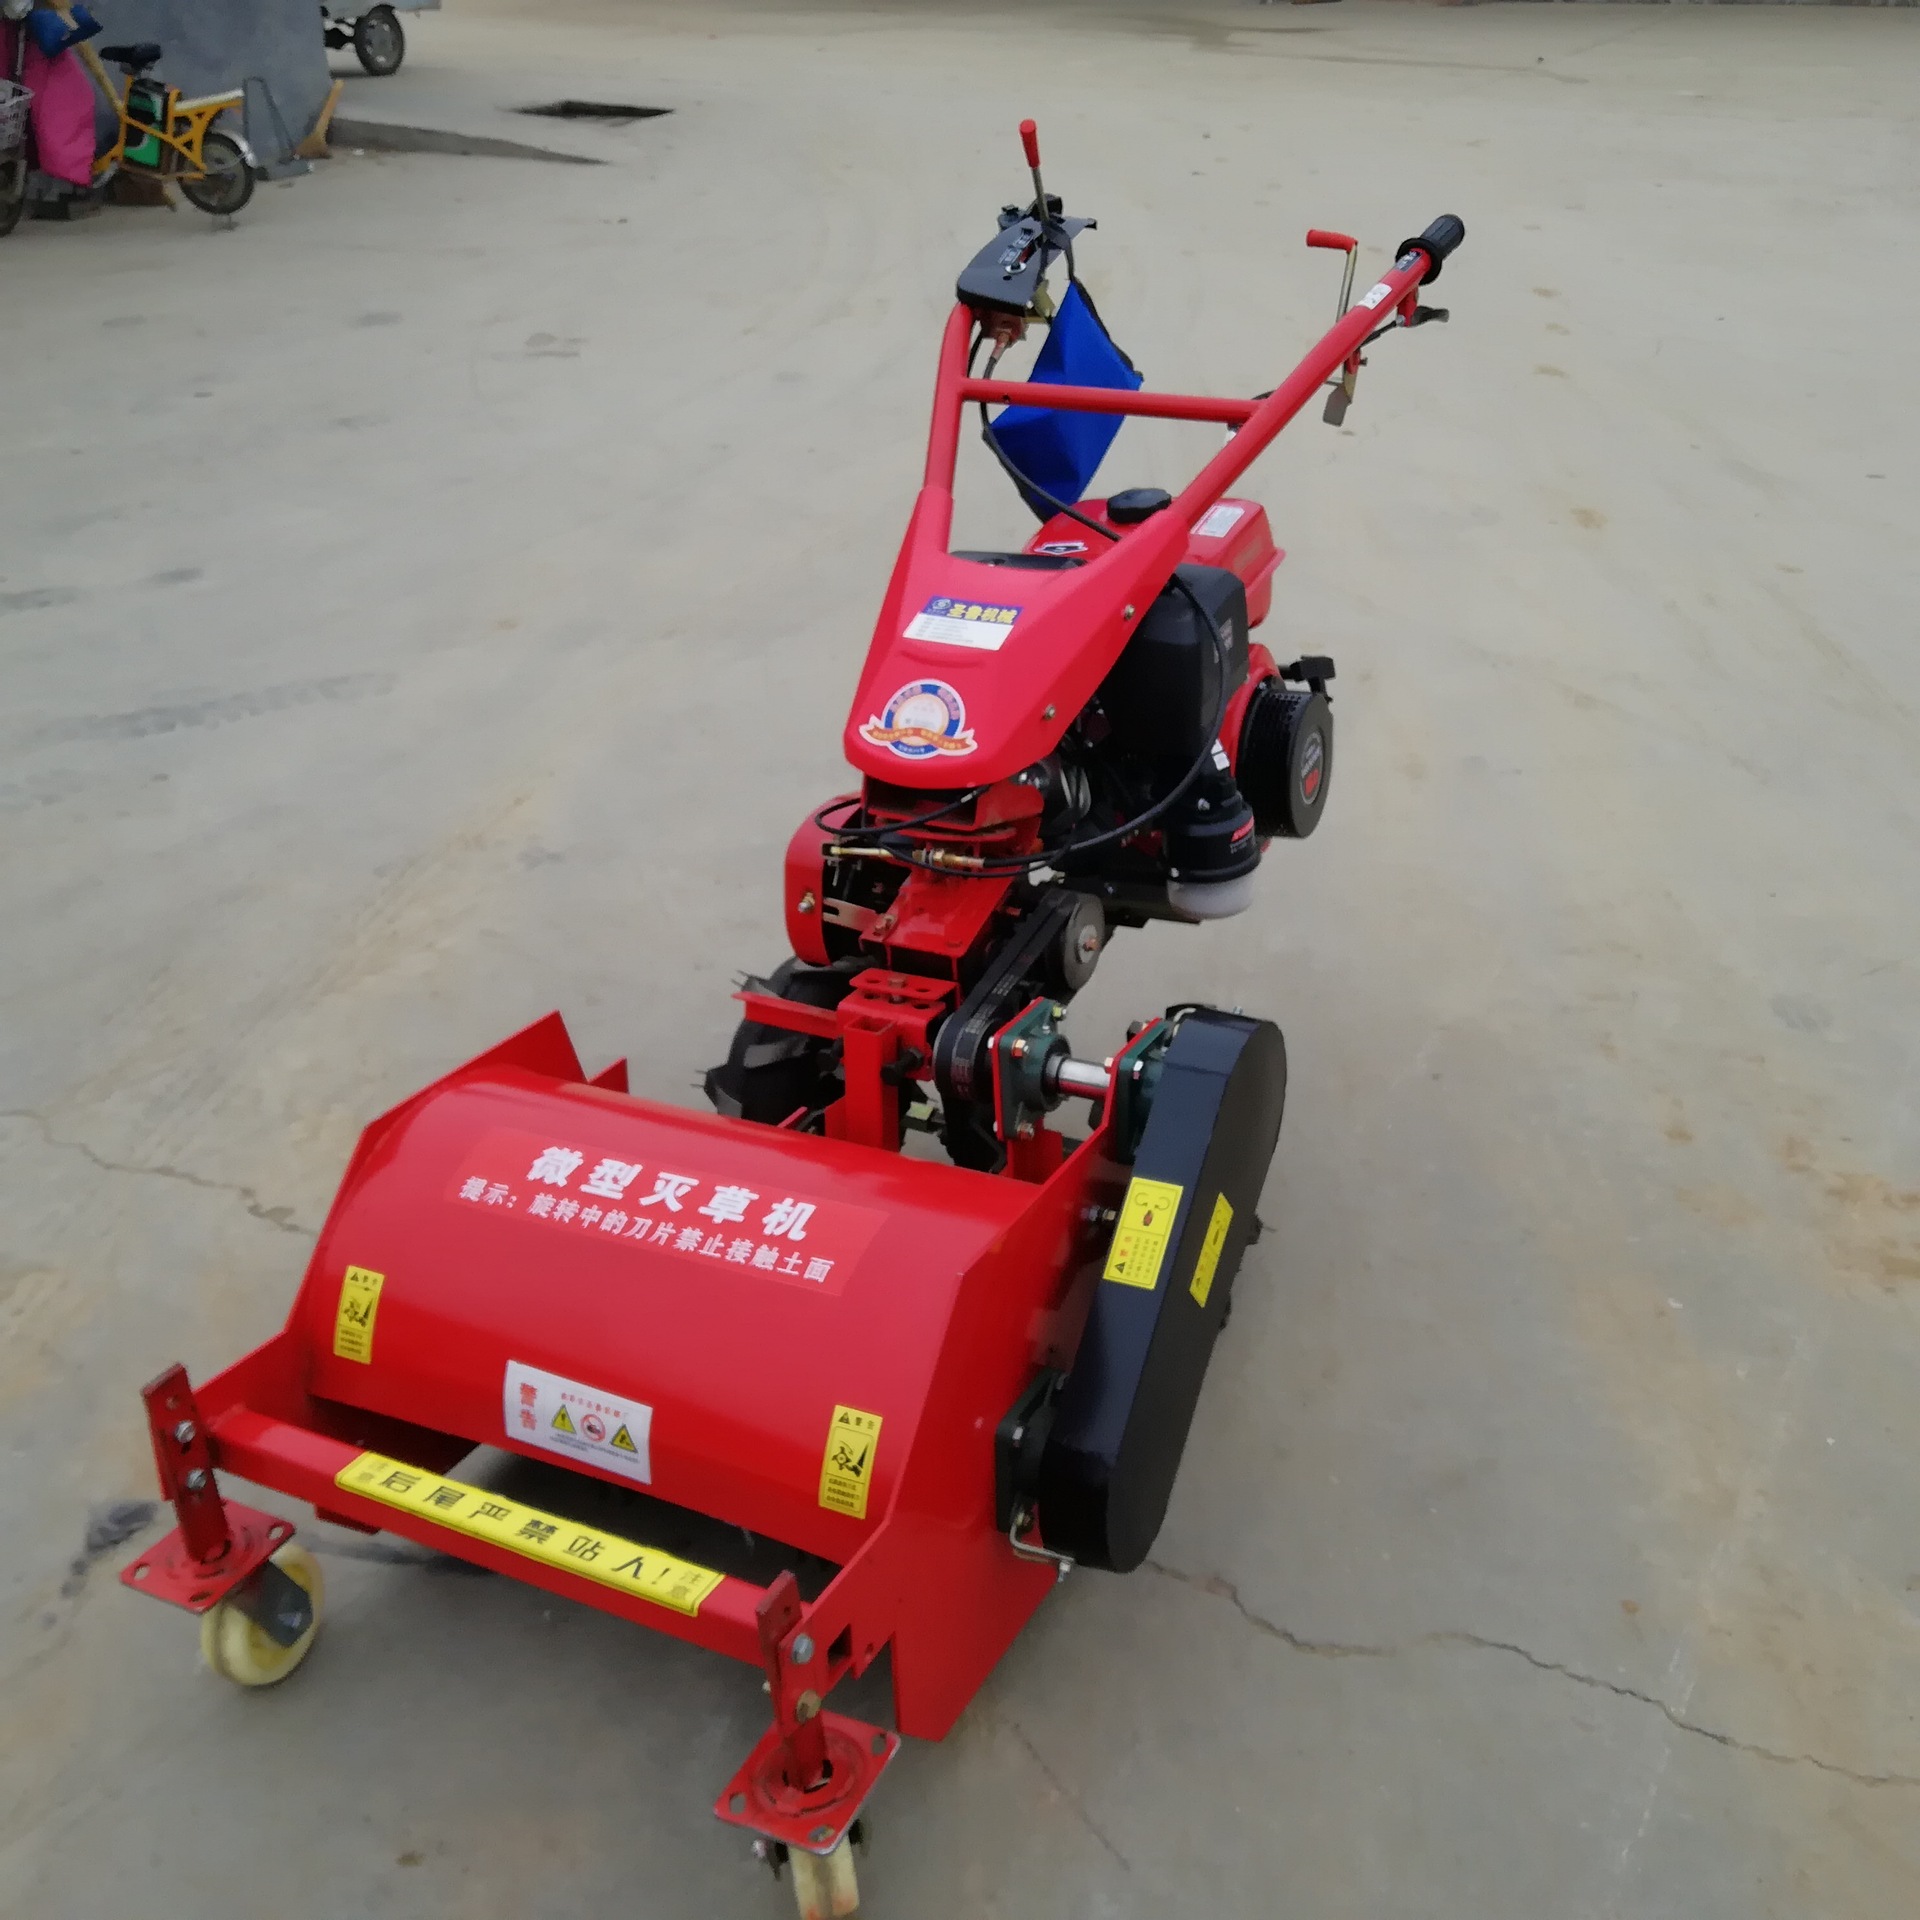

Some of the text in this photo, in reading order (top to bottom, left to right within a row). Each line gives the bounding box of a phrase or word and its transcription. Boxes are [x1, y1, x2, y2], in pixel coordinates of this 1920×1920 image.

[526, 1146, 818, 1241] 微型灭草机
